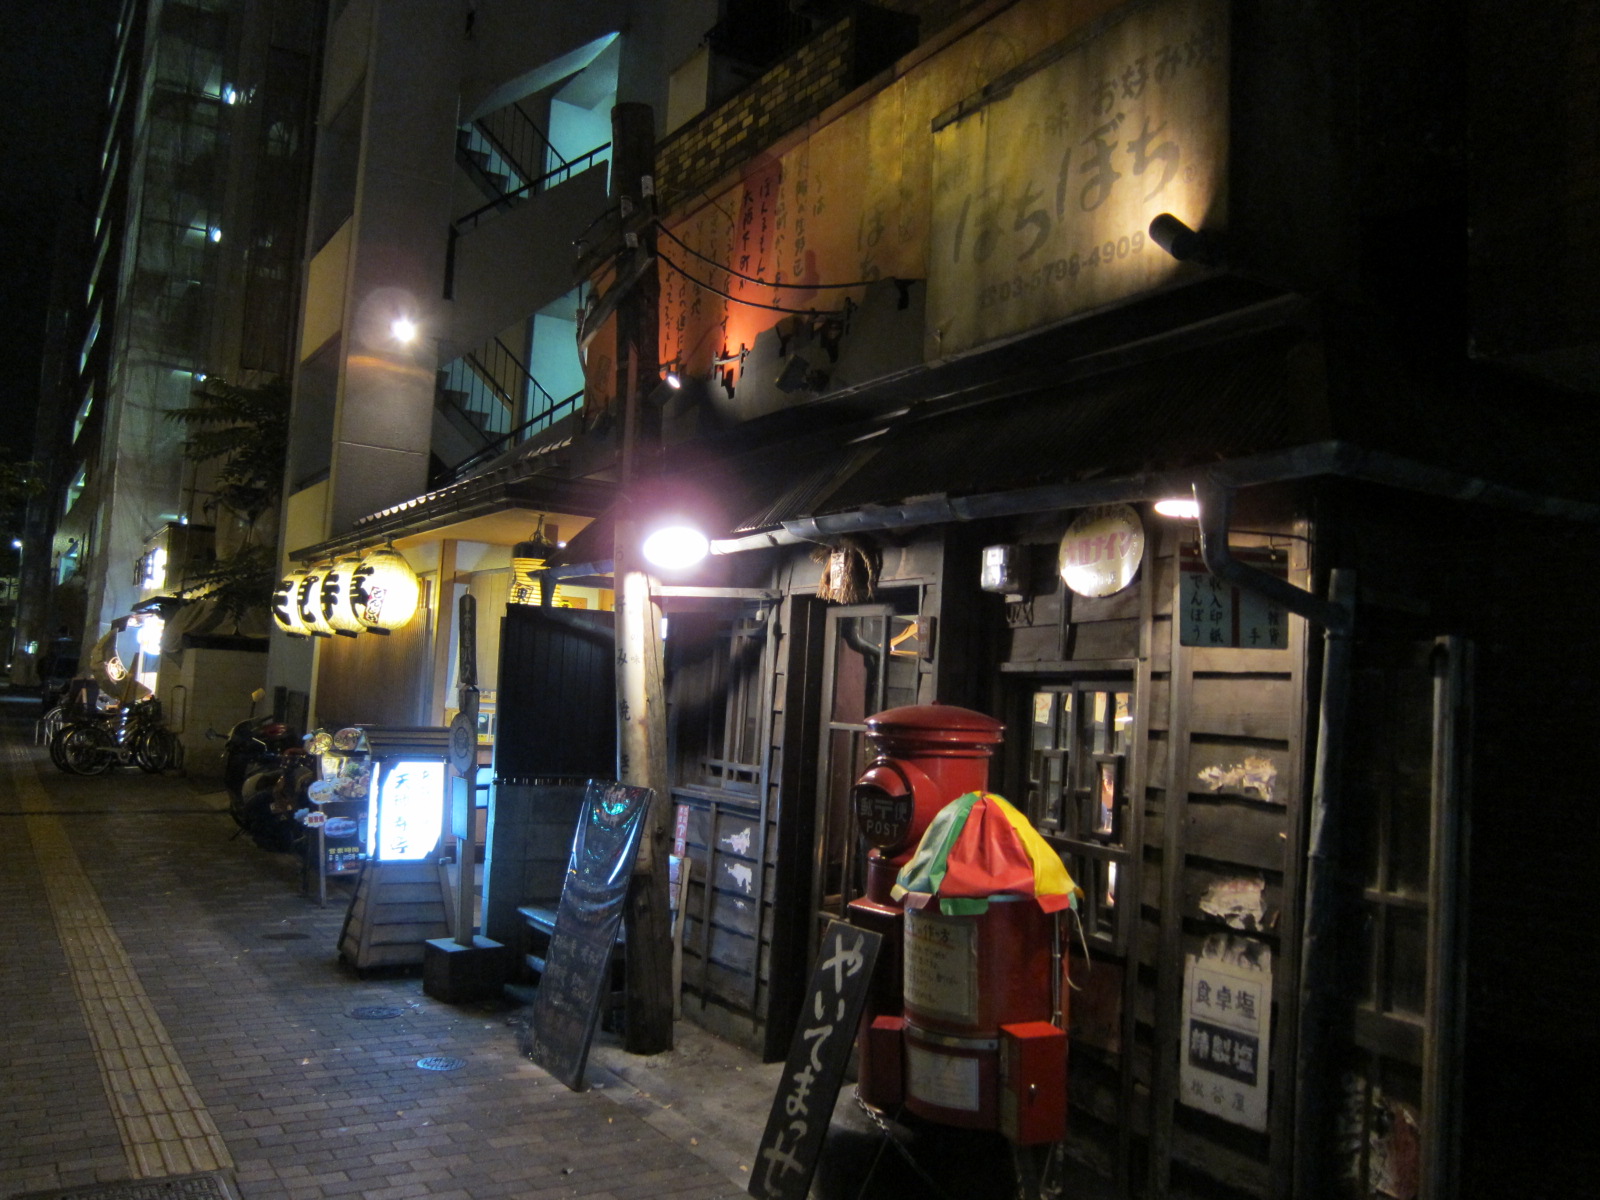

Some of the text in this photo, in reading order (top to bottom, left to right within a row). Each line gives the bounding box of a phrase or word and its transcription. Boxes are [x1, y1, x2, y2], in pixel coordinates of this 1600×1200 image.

[866, 819, 900, 838] POST
[1196, 980, 1256, 1021] 食卓塩
[763, 933, 865, 1197] やいてまっせ
